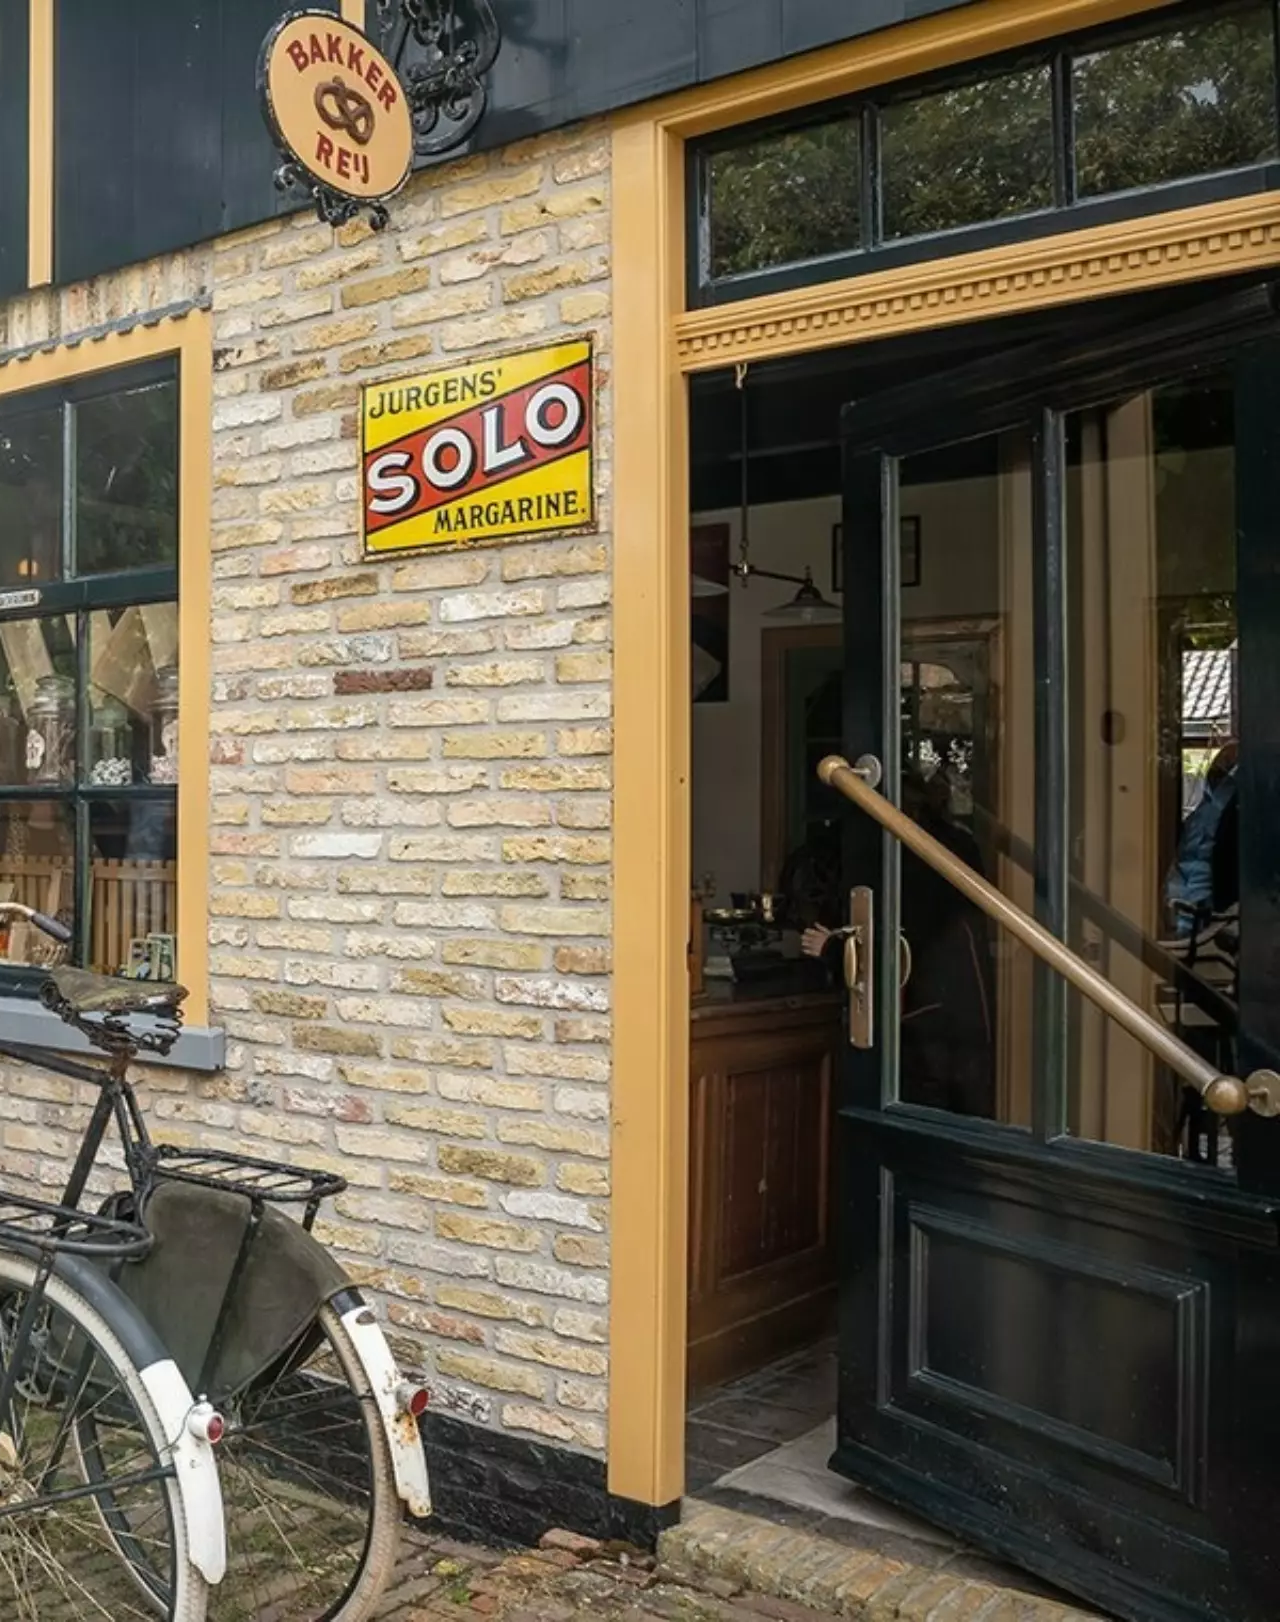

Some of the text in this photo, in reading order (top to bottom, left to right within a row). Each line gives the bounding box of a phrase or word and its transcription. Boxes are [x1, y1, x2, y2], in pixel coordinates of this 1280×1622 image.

[285, 32, 398, 113] BAKKER
[315, 131, 371, 184] REIJ
[369, 367, 503, 419] JURGENS'
[367, 381, 584, 516] SOLO
